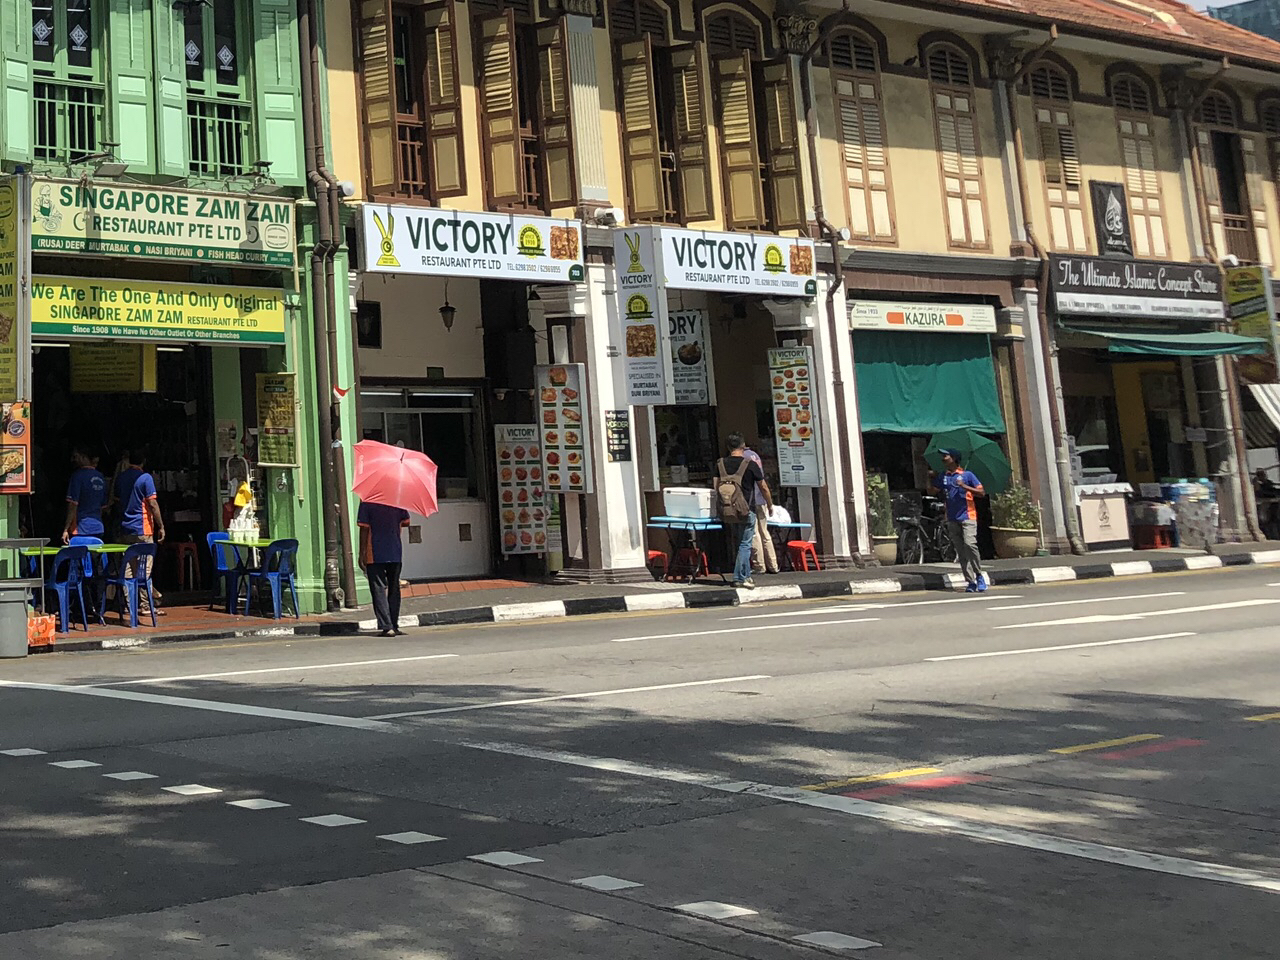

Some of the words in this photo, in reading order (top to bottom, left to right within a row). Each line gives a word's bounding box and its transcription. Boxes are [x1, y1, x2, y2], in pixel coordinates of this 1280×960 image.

[60, 186, 189, 216] SINGAPORE
[195, 197, 239, 220] ZAM
[247, 202, 290, 224] ZAM
[93, 216, 184, 237] RESTAURANT
[188, 223, 213, 239] PTE
[217, 225, 241, 241] LTD
[406, 216, 511, 255] VICTORY
[37, 238, 64, 248] (RUSA)
[65, 240, 85, 249] DEER
[88, 242, 130, 252] MURTABAK
[145, 245, 163, 254] NASI
[164, 246, 193, 257] BRIYANI
[208, 250, 225, 259] FISH
[225, 251, 244, 260] HEAD
[245, 252, 269, 262] CURRY
[672, 237, 758, 271] VICTORY
[421, 255, 471, 269] RESTAURANT
[472, 258, 487, 269] PTE
[488, 259, 502, 270] LTD
[620, 274, 653, 285] VICTORY
[685, 272, 725, 284] RESTAURANT
[727, 275, 738, 285] PTE
[739, 276, 751, 285] LTD
[1059, 260, 1080, 286] The
[1081, 261, 1121, 289] Ultimate
[1123, 264, 1157, 289] Islamic
[1157, 267, 1194, 298] Concept
[1194, 269, 1218, 293] Store
[31, 283, 54, 300] We
[59, 284, 86, 301] Are
[90, 286, 117, 302] The
[122, 288, 151, 304] One
[156, 290, 183, 306] And
[188, 291, 219, 311] Only
[223, 293, 278, 313] Original
[50, 305, 121, 321] SINGAPORE
[126, 308, 152, 323] ZAM
[157, 310, 183, 324] ZAM
[187, 316, 231, 326] RESTAURANT
[233, 318, 245, 327] PTE
[246, 319, 258, 327] LTD
[905, 312, 946, 326] KAZURA
[72, 325, 90, 333] Since
[91, 326, 109, 334] 1908
[123, 327, 138, 335] Have
[167, 330, 186, 338] Outlet
[778, 349, 805, 357] VICTORY
[506, 428, 535, 437] VICTORY
